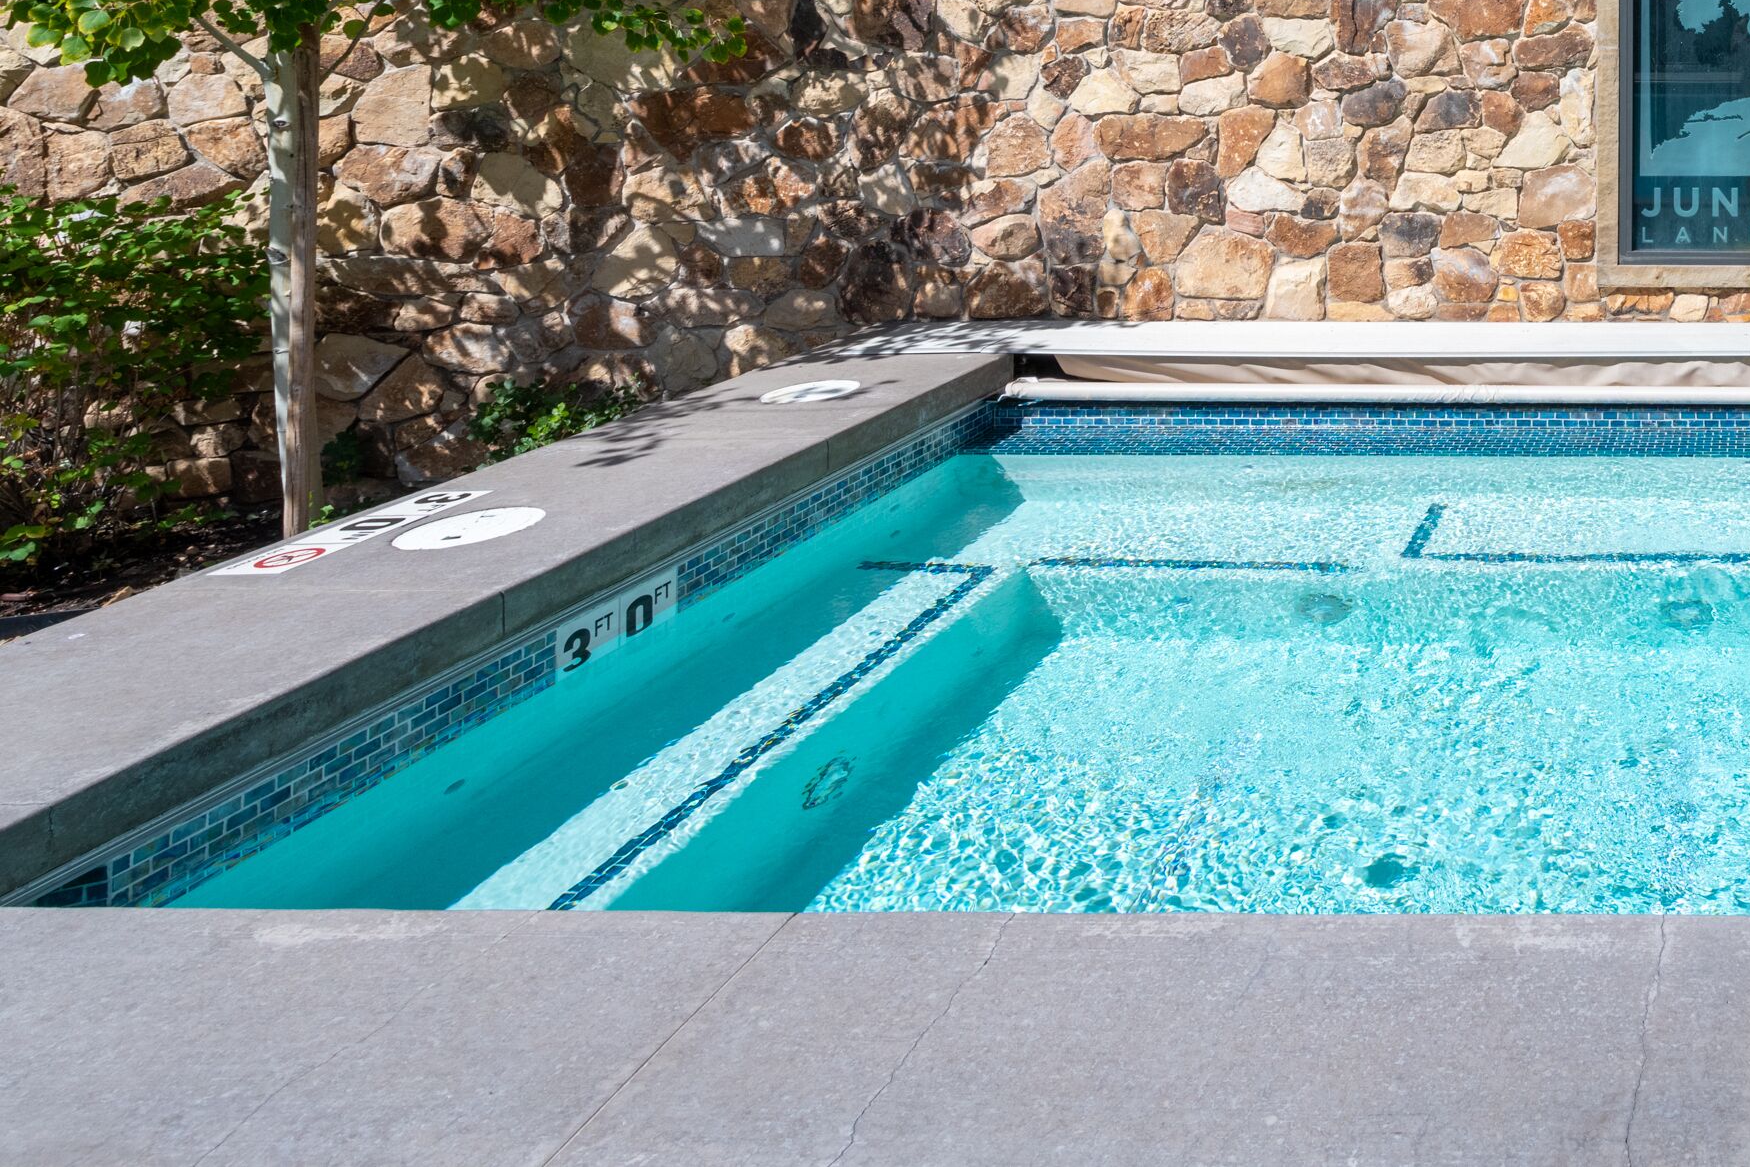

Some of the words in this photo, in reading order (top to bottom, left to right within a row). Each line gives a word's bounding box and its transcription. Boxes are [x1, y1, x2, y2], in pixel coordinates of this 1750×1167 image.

[563, 628, 591, 672] 3
[595, 612, 613, 637] FT
[626, 594, 653, 637] 0
[655, 580, 671, 605] FT
